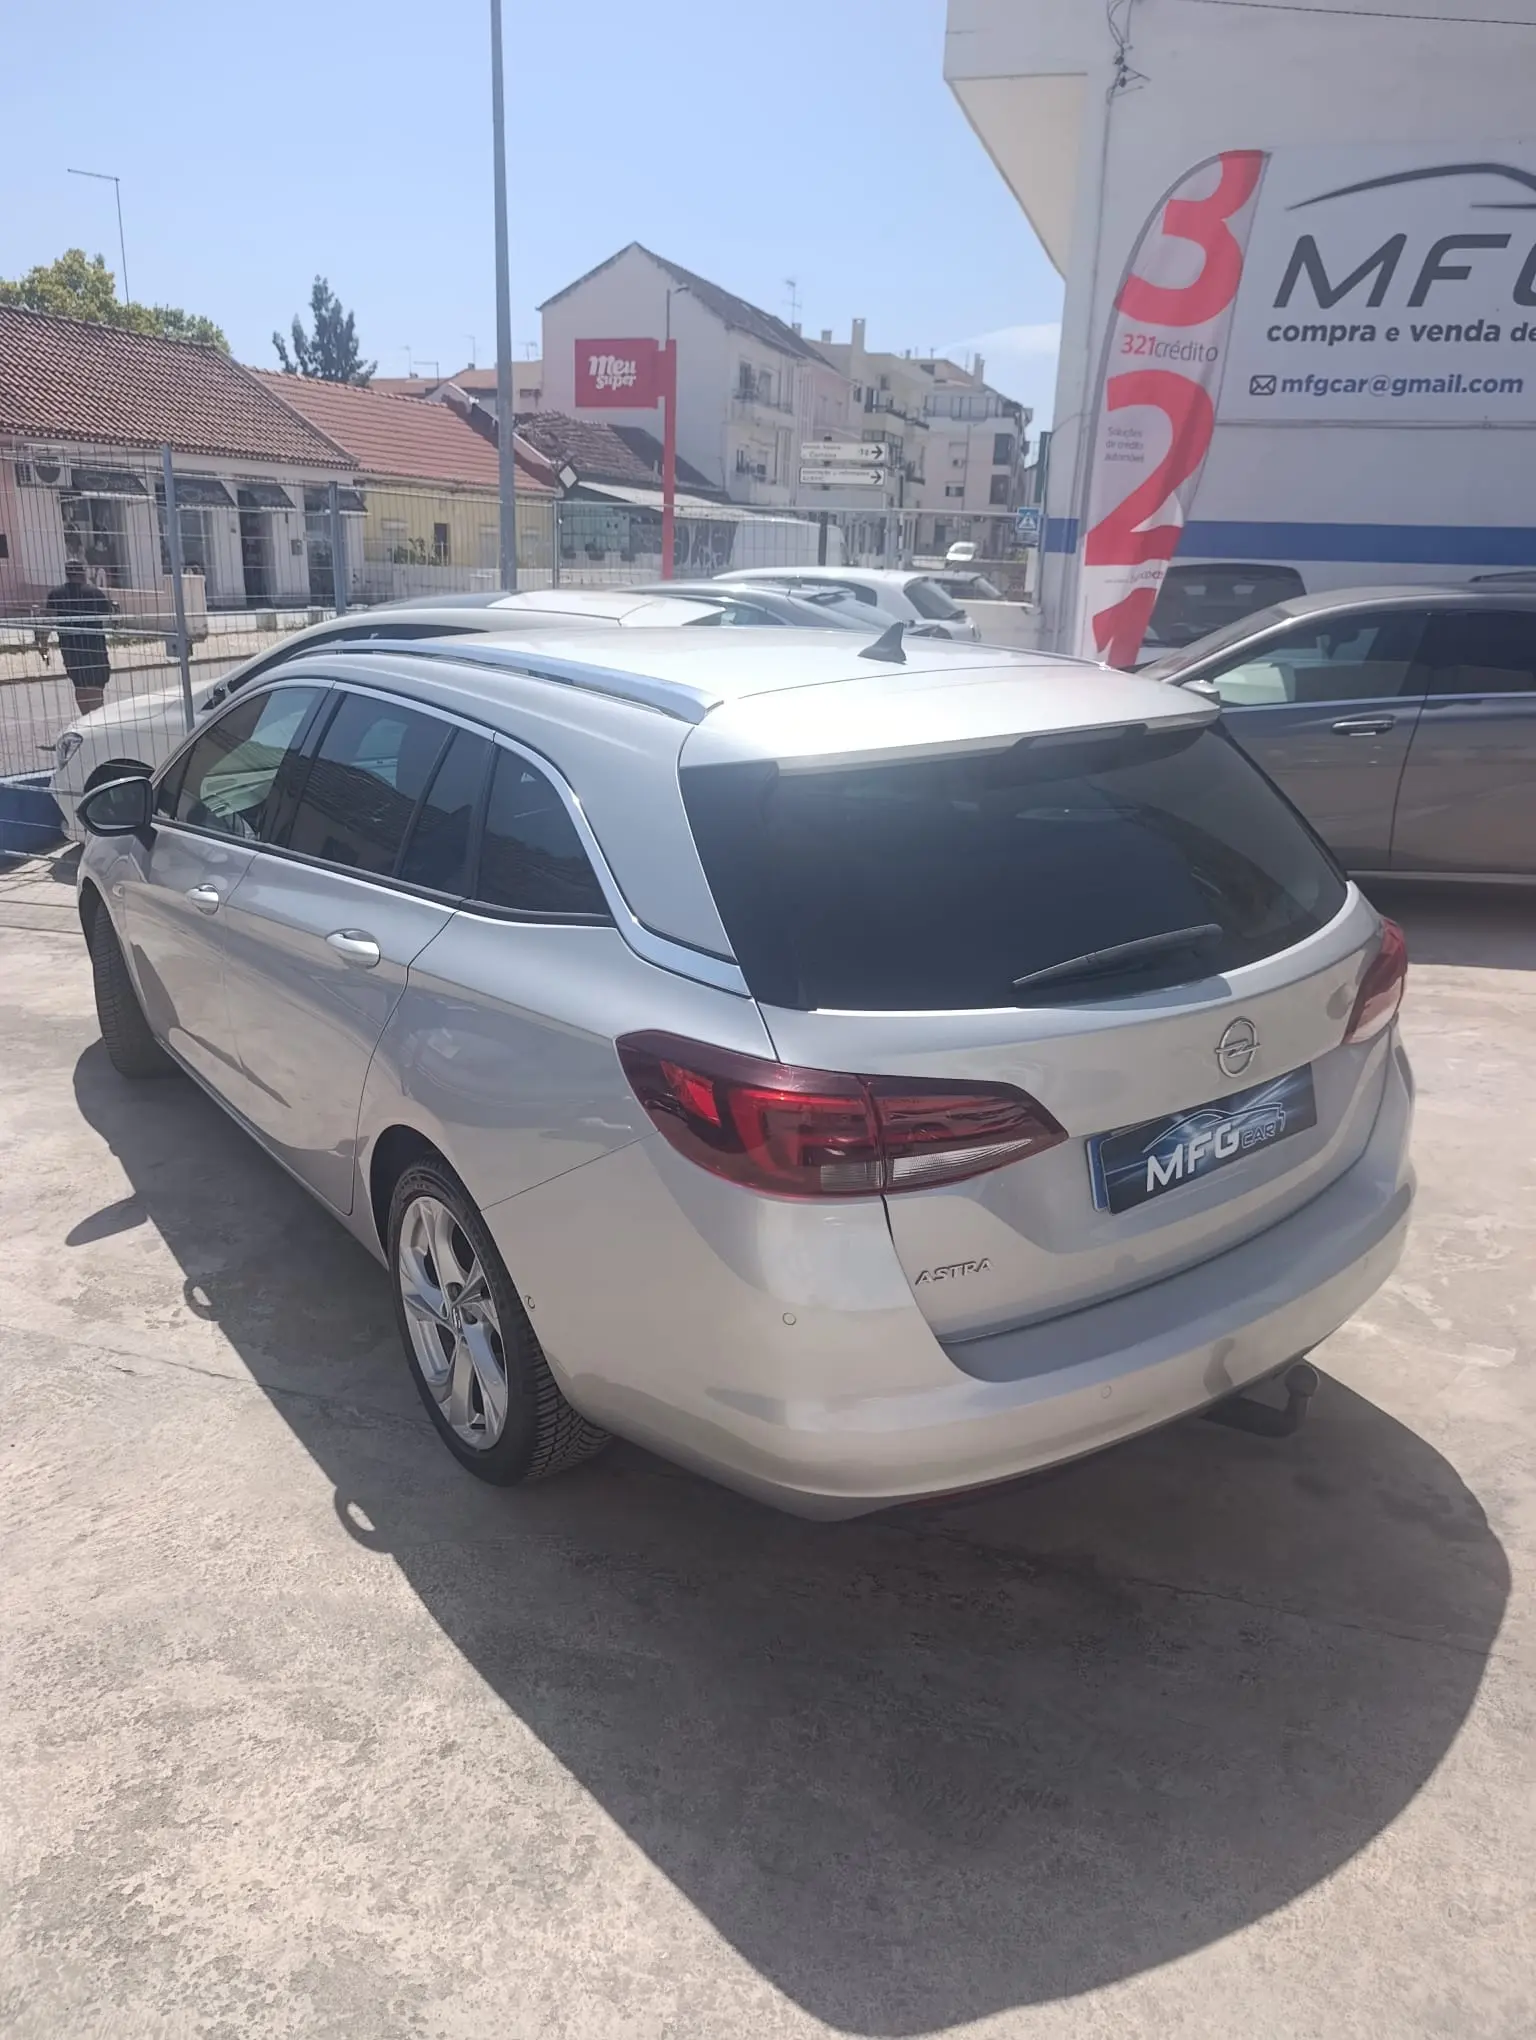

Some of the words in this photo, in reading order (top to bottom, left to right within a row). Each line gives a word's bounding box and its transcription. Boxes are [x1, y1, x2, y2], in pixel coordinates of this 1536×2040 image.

[1114, 150, 1263, 327] 3
[1272, 233, 1536, 309] MF
[1267, 324, 1377, 346] compra
[1385, 327, 1400, 342] e
[1410, 319, 1501, 343] venda
[588, 355, 637, 376] Meu
[595, 375, 637, 391] super
[1281, 374, 1524, 397] mfgcar@gmail.com
[1085, 369, 1214, 566] 2
[1146, 1122, 1241, 1193] MFG
[1241, 1121, 1277, 1150] CAR
[914, 1258, 992, 1286] ASTRA
